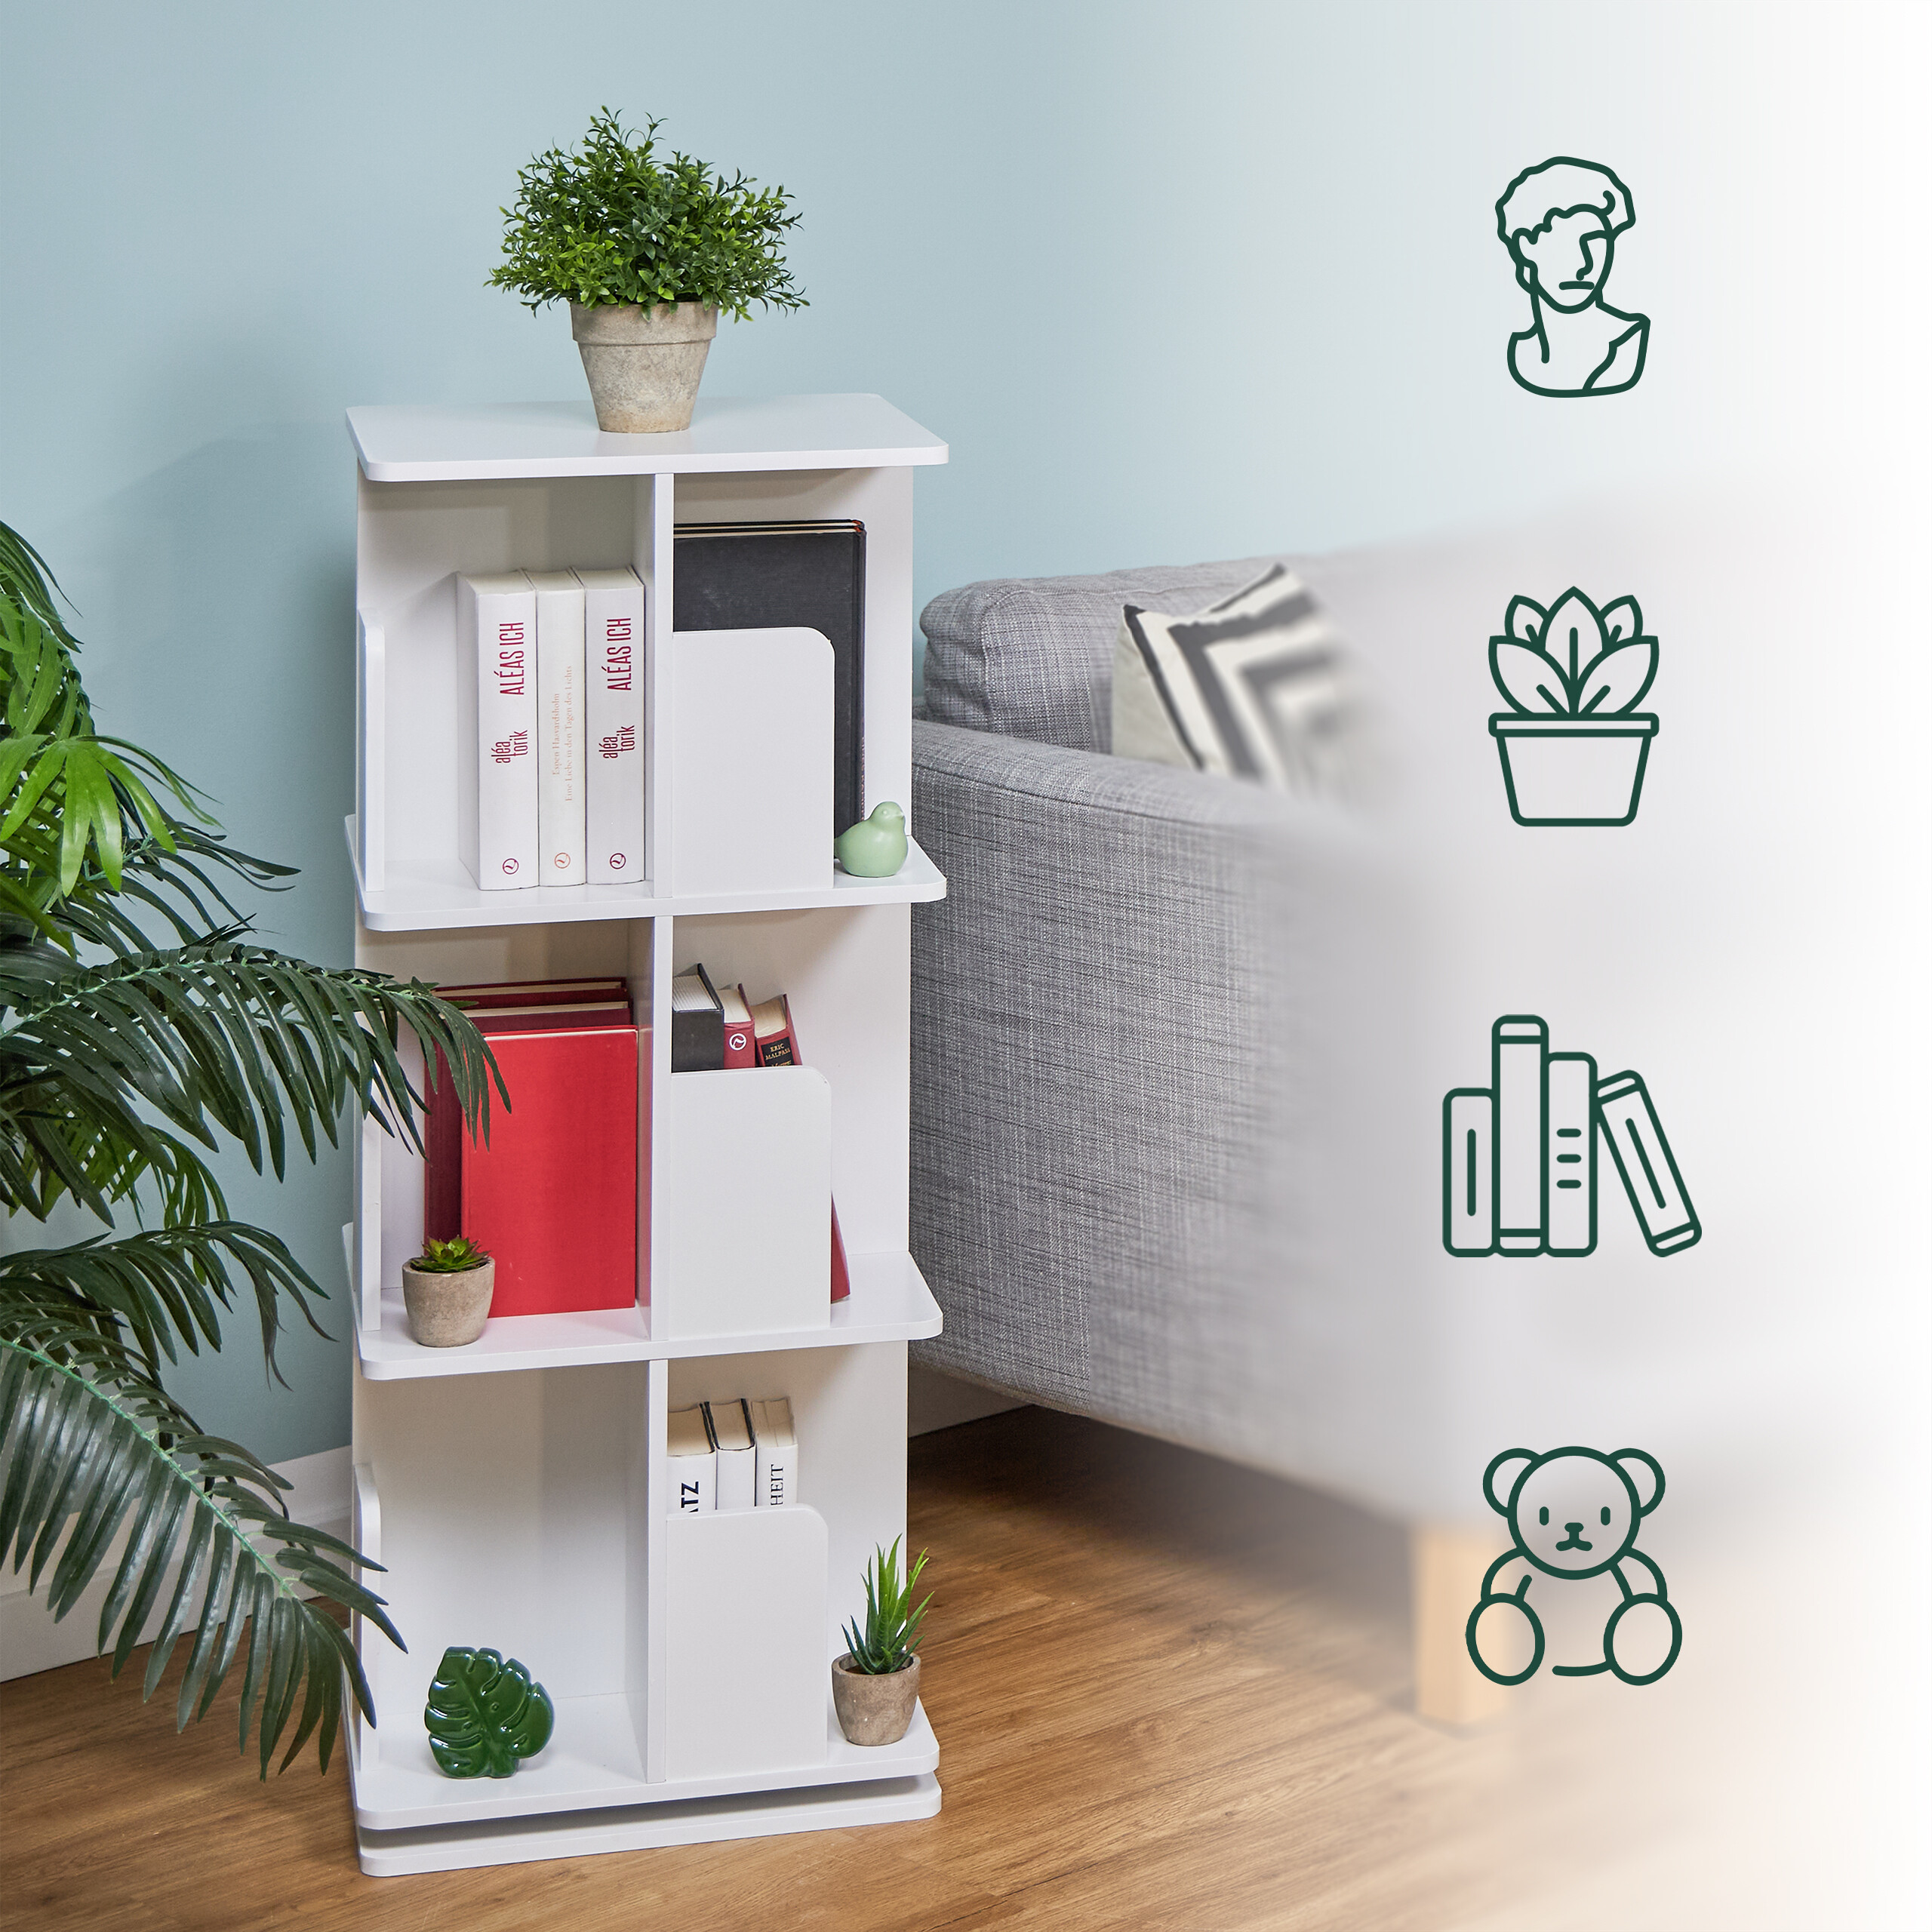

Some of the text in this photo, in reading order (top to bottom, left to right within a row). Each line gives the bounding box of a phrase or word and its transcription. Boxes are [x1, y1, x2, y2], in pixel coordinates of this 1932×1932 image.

[494, 622, 525, 695] ALÉAS ICH
[601, 618, 632, 691] ALÉAS ICH
[565, 666, 573, 690] Lichts
[565, 708, 574, 731] Tagen
[509, 730, 528, 757] torik
[565, 734, 573, 748] den
[598, 737, 618, 759] aléa
[616, 725, 635, 752] torik
[491, 741, 512, 764] aléa
[552, 752, 561, 775] Espen
[565, 760, 573, 781] Liebe
[770, 1043, 785, 1052] ERIC
[681, 1481, 699, 1513] TZ
